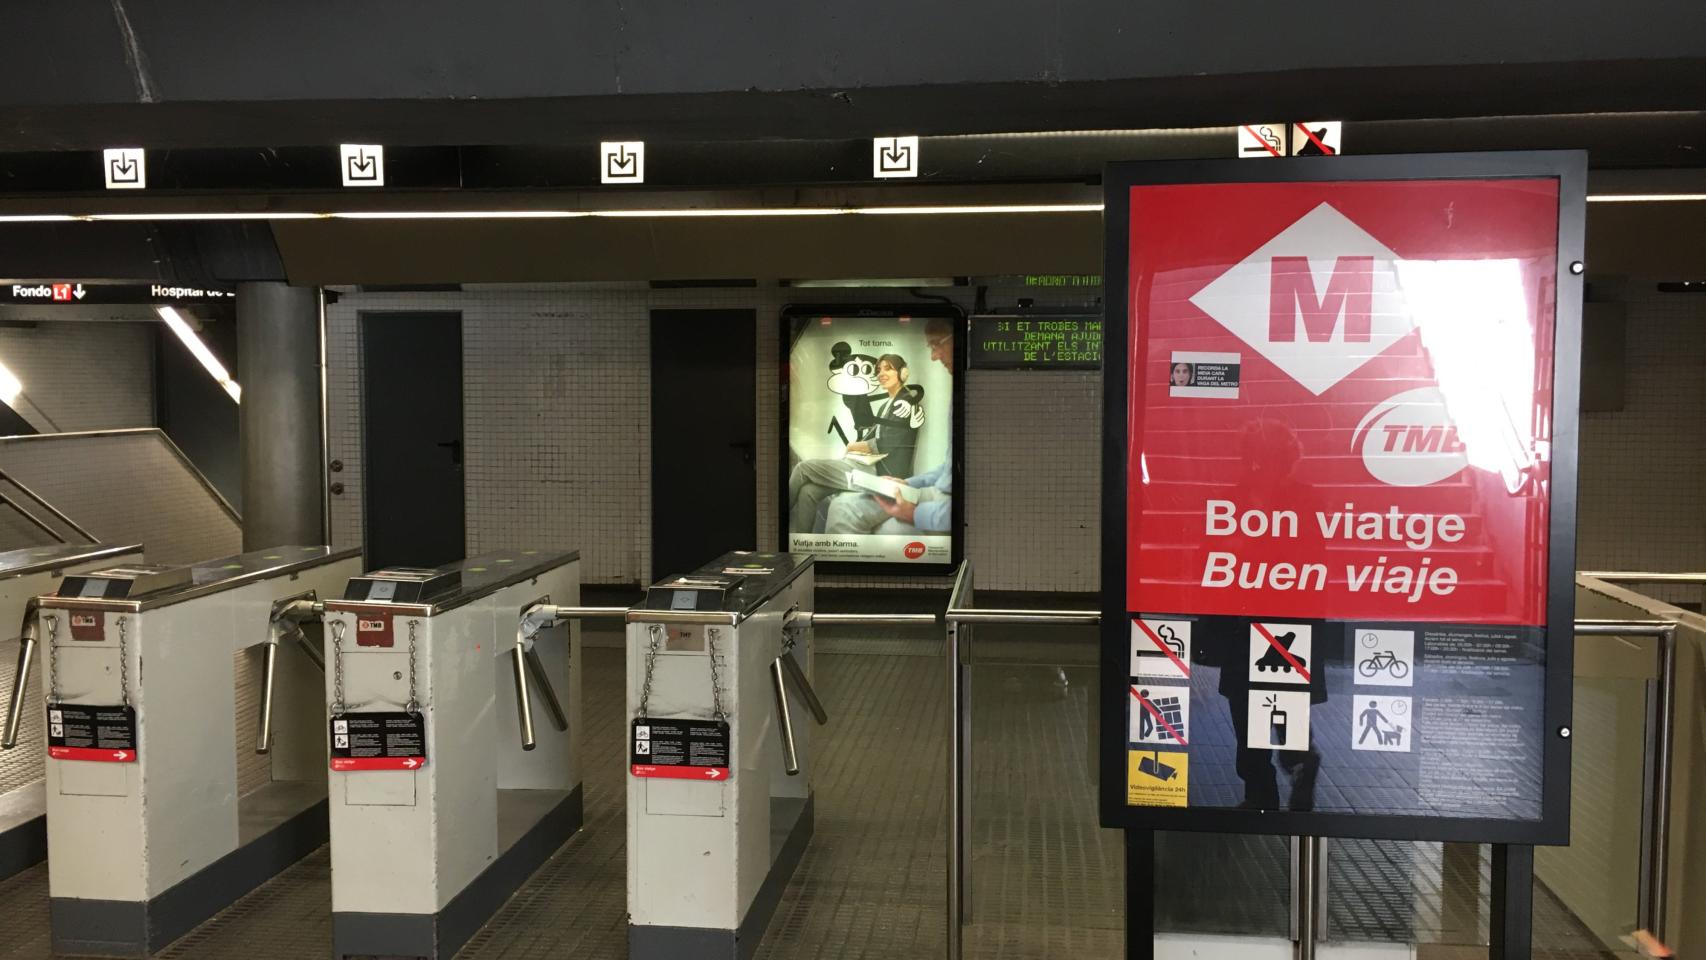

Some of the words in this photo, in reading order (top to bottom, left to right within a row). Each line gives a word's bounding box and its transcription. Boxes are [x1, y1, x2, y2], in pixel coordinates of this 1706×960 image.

[13, 285, 51, 297] Fondo
[54, 285, 68, 299] L1
[1269, 256, 1374, 342] M
[1017, 322, 1030, 331] ET
[1039, 322, 1078, 331] TROBES
[1024, 332, 1065, 341] DEMANA
[859, 339, 871, 347] Tot
[873, 339, 894, 347] torna.
[983, 341, 1051, 351] UTILITZANT
[1058, 341, 1078, 351] ELS
[1024, 351, 1037, 361] DE
[1205, 499, 1298, 538] Bon
[1315, 502, 1466, 550] viatge
[793, 539, 813, 548] Viatja
[1200, 551, 1328, 591] Buen
[1345, 556, 1459, 603] viaje
